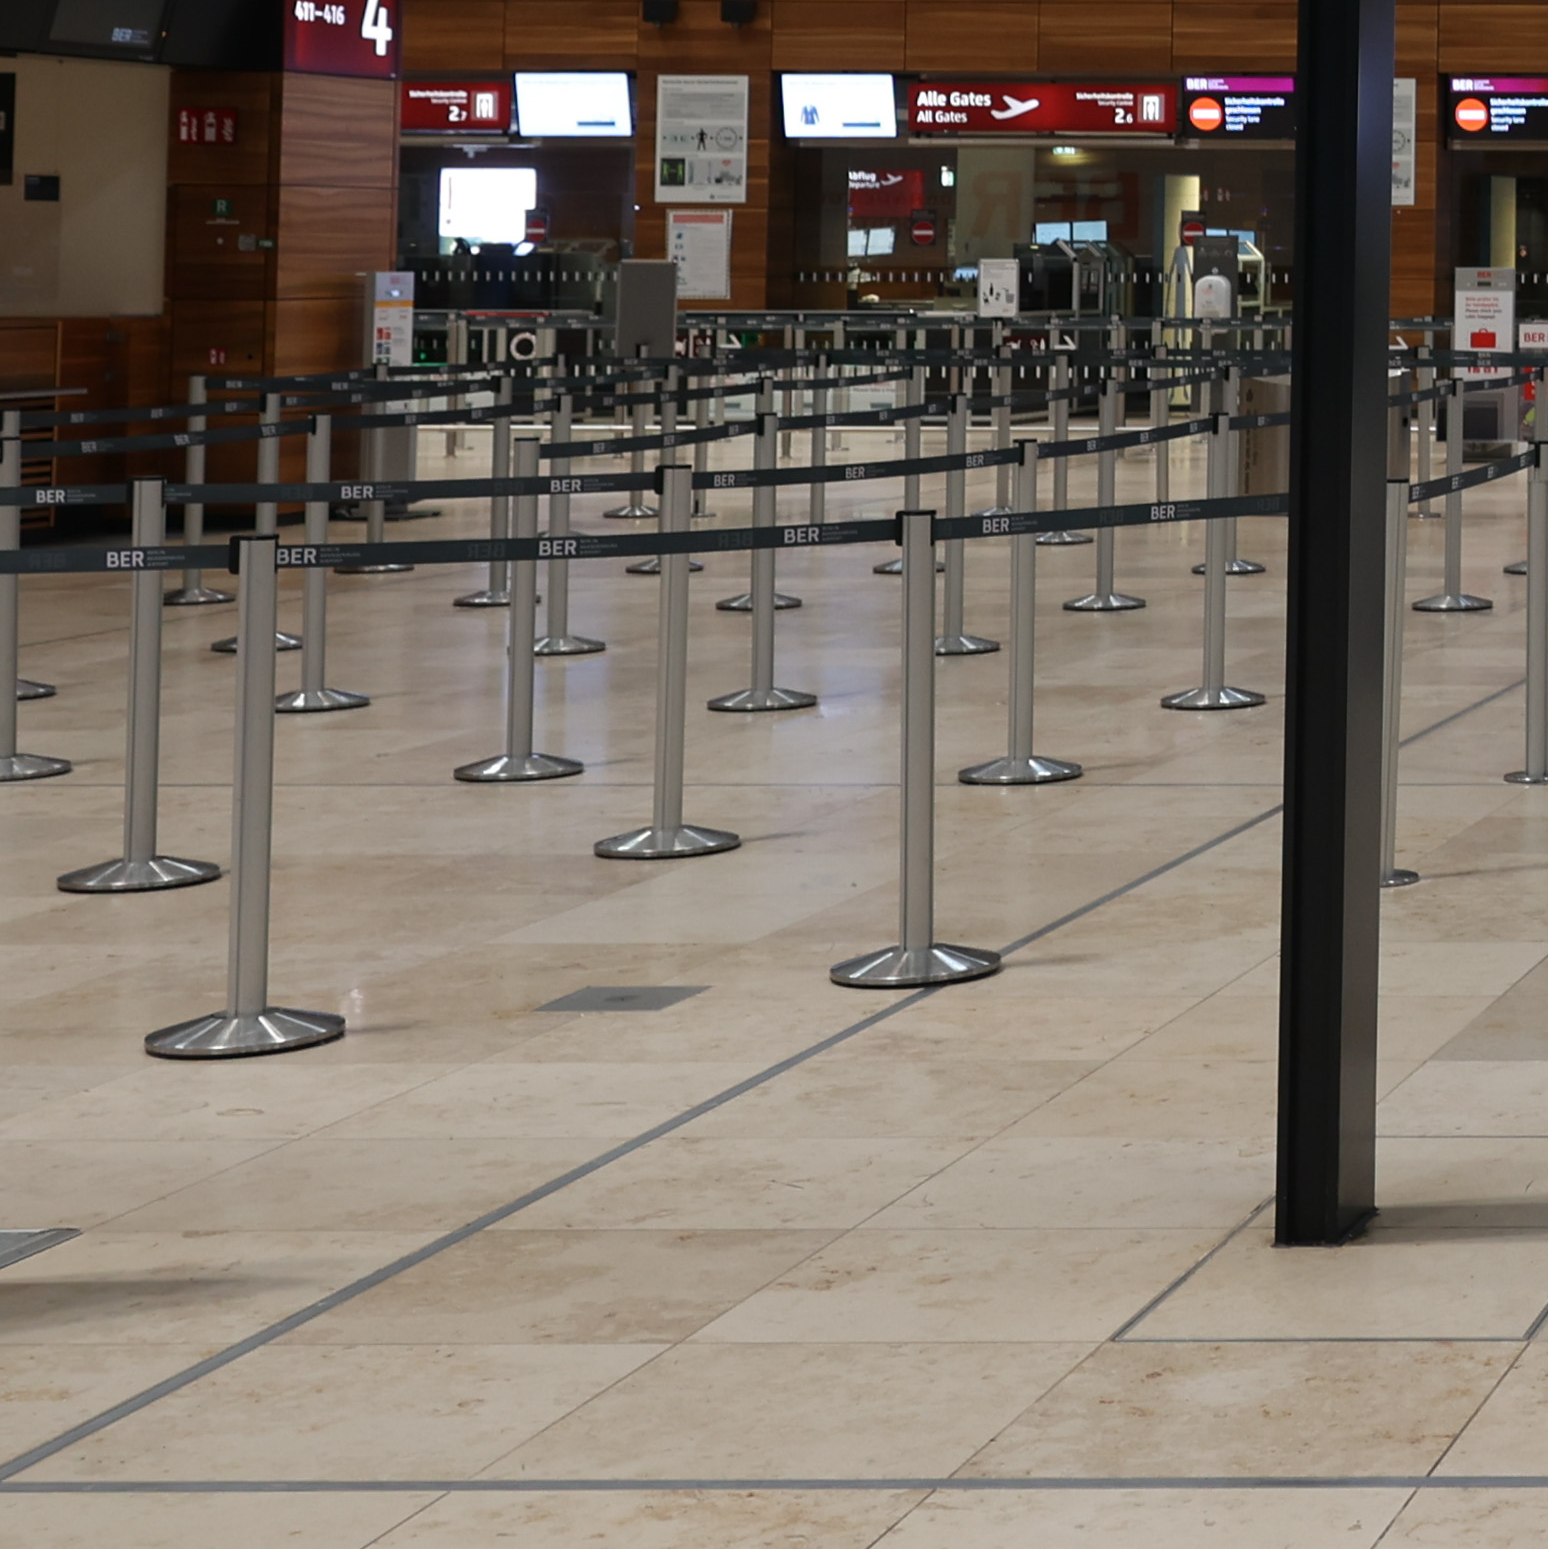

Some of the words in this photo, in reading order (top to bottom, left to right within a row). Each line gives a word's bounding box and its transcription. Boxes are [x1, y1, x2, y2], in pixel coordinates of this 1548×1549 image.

[1452, 79, 1473, 91] BER
[917, 90, 947, 107] Alle
[950, 92, 992, 107] Gates
[917, 110, 933, 123] All
[935, 111, 968, 124] Gates
[1524, 333, 1545, 343] BER
[341, 485, 373, 499] BER
[784, 527, 819, 543] BER
[539, 540, 576, 556] BER
[107, 551, 144, 567] BER
